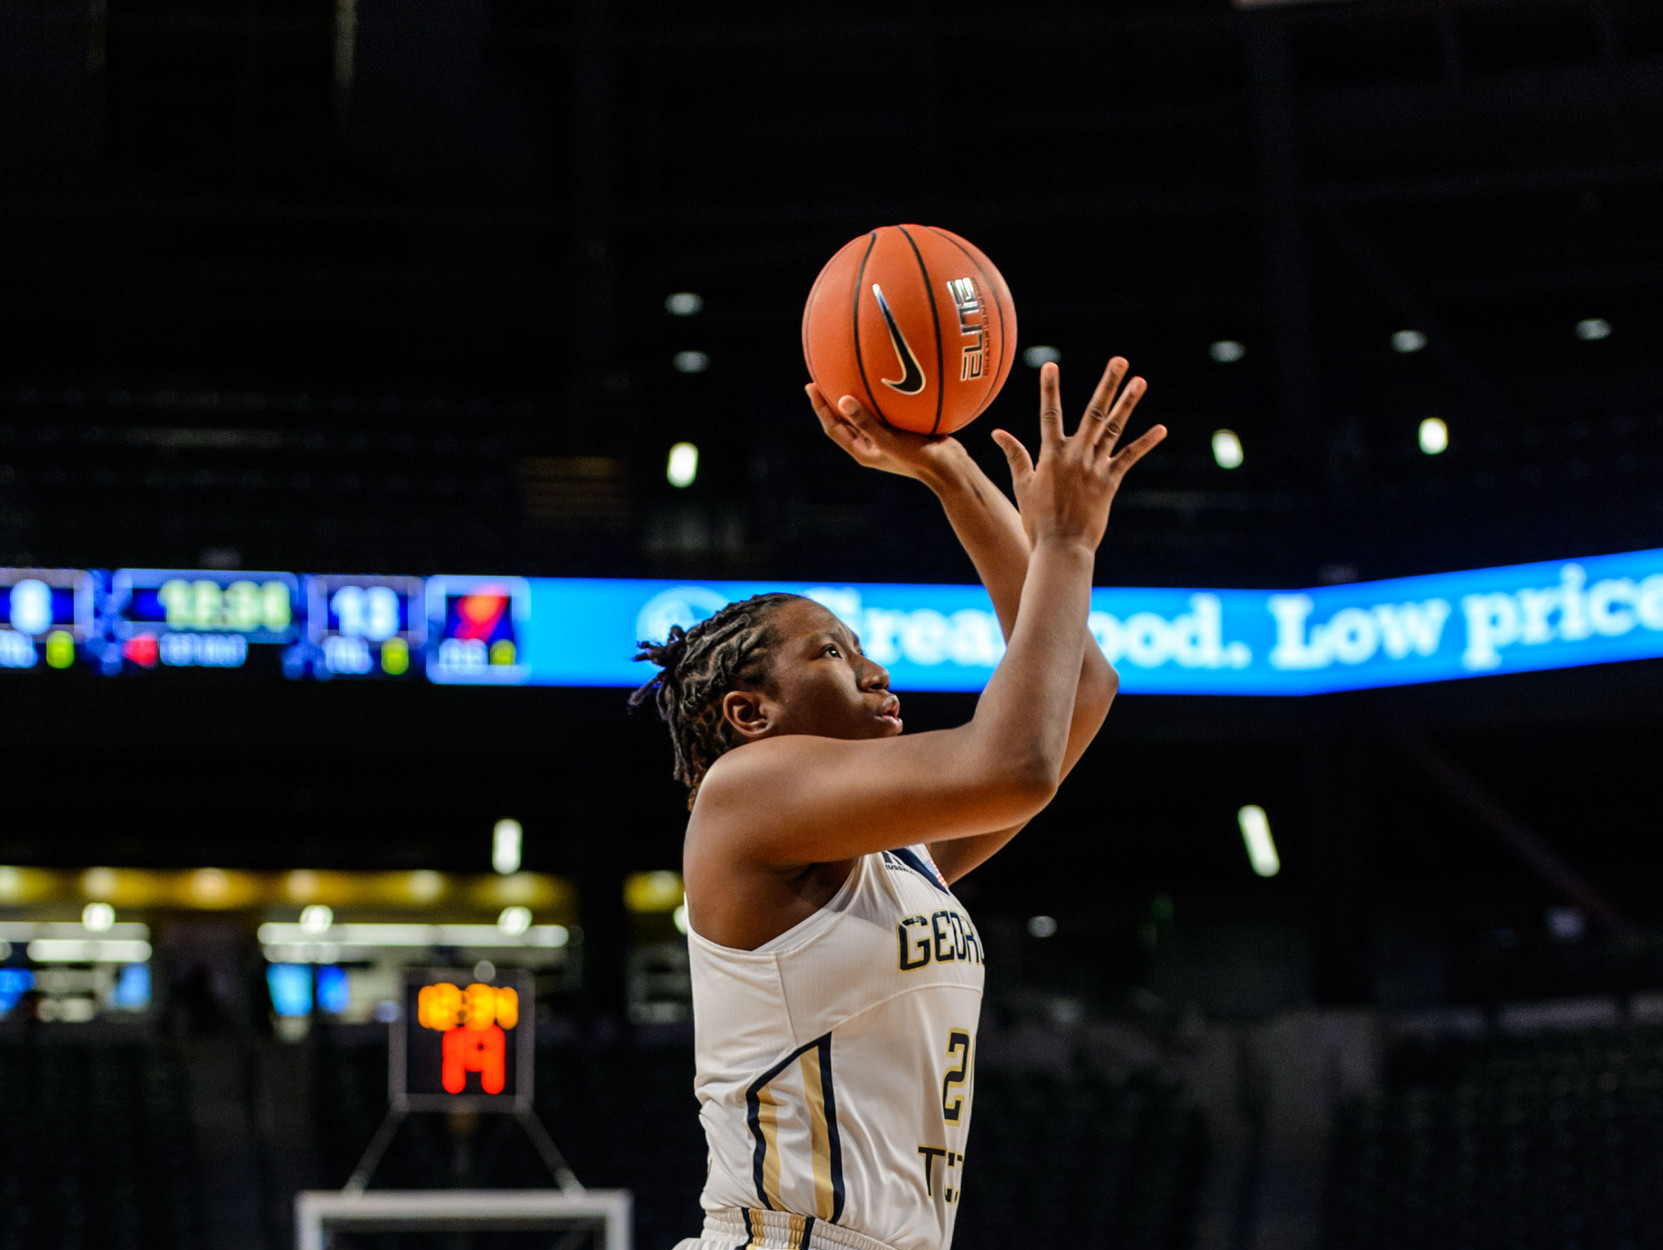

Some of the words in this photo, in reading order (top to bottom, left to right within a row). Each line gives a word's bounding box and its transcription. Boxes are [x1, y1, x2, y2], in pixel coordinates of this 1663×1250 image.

[946, 277, 983, 382] ELITE
[802, 586, 1004, 668] rea
[1087, 592, 1252, 669] ood.
[1267, 593, 1452, 671] Low
[896, 908, 985, 973] GEOR
